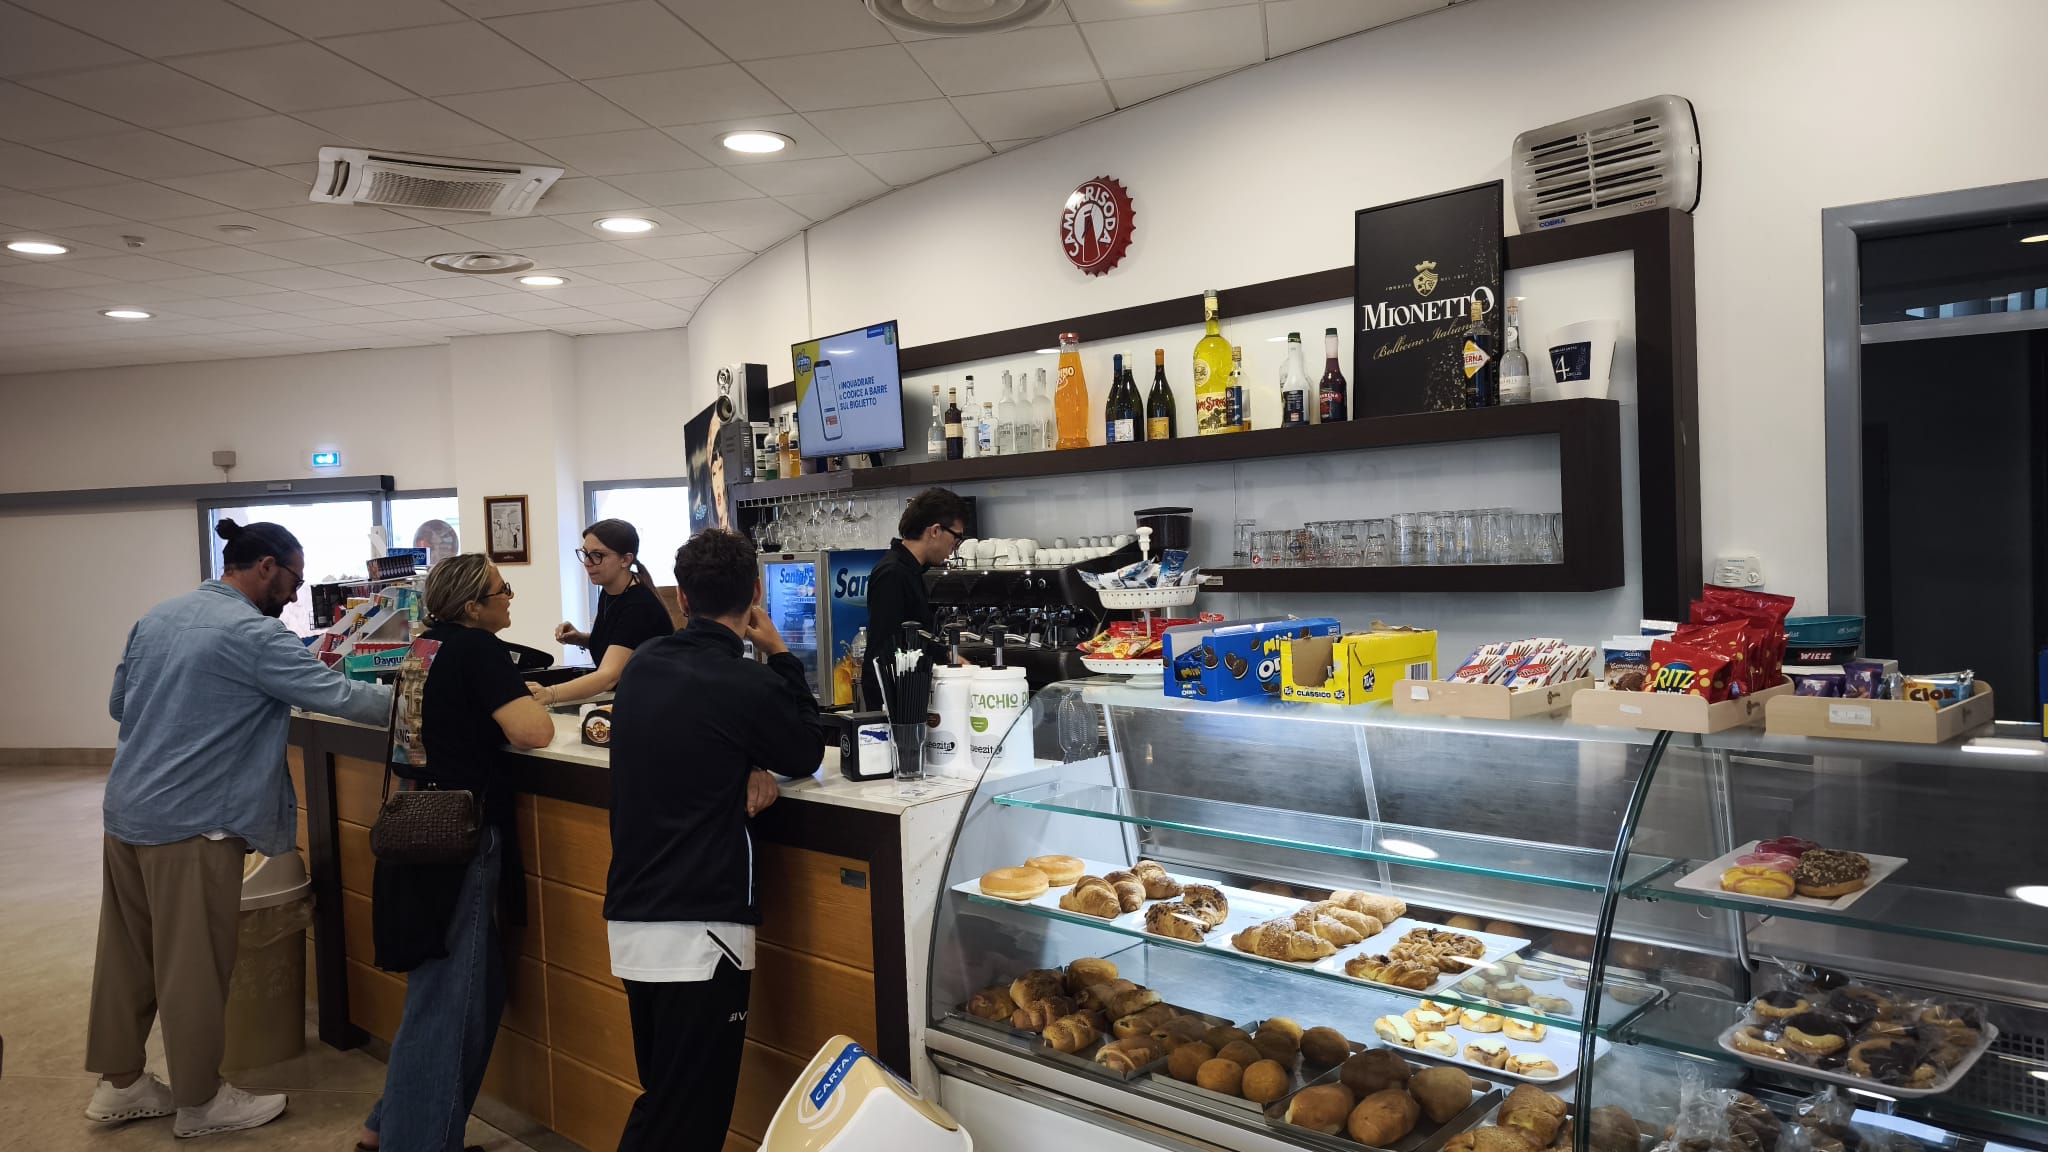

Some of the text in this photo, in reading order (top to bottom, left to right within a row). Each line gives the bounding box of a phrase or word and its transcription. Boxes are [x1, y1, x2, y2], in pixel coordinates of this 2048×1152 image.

[1538, 218, 1566, 229] COBRA
[1361, 286, 1495, 331] MIONETTO
[1464, 355, 1483, 363] ERNA
[842, 388, 863, 400] CODICE
[869, 384, 888, 396] BARRE
[849, 397, 877, 409] BIGLIETTO
[373, 655, 405, 668] Daygu
[1800, 652, 1832, 660] WIEZE
[1653, 667, 1697, 689] RITZ
